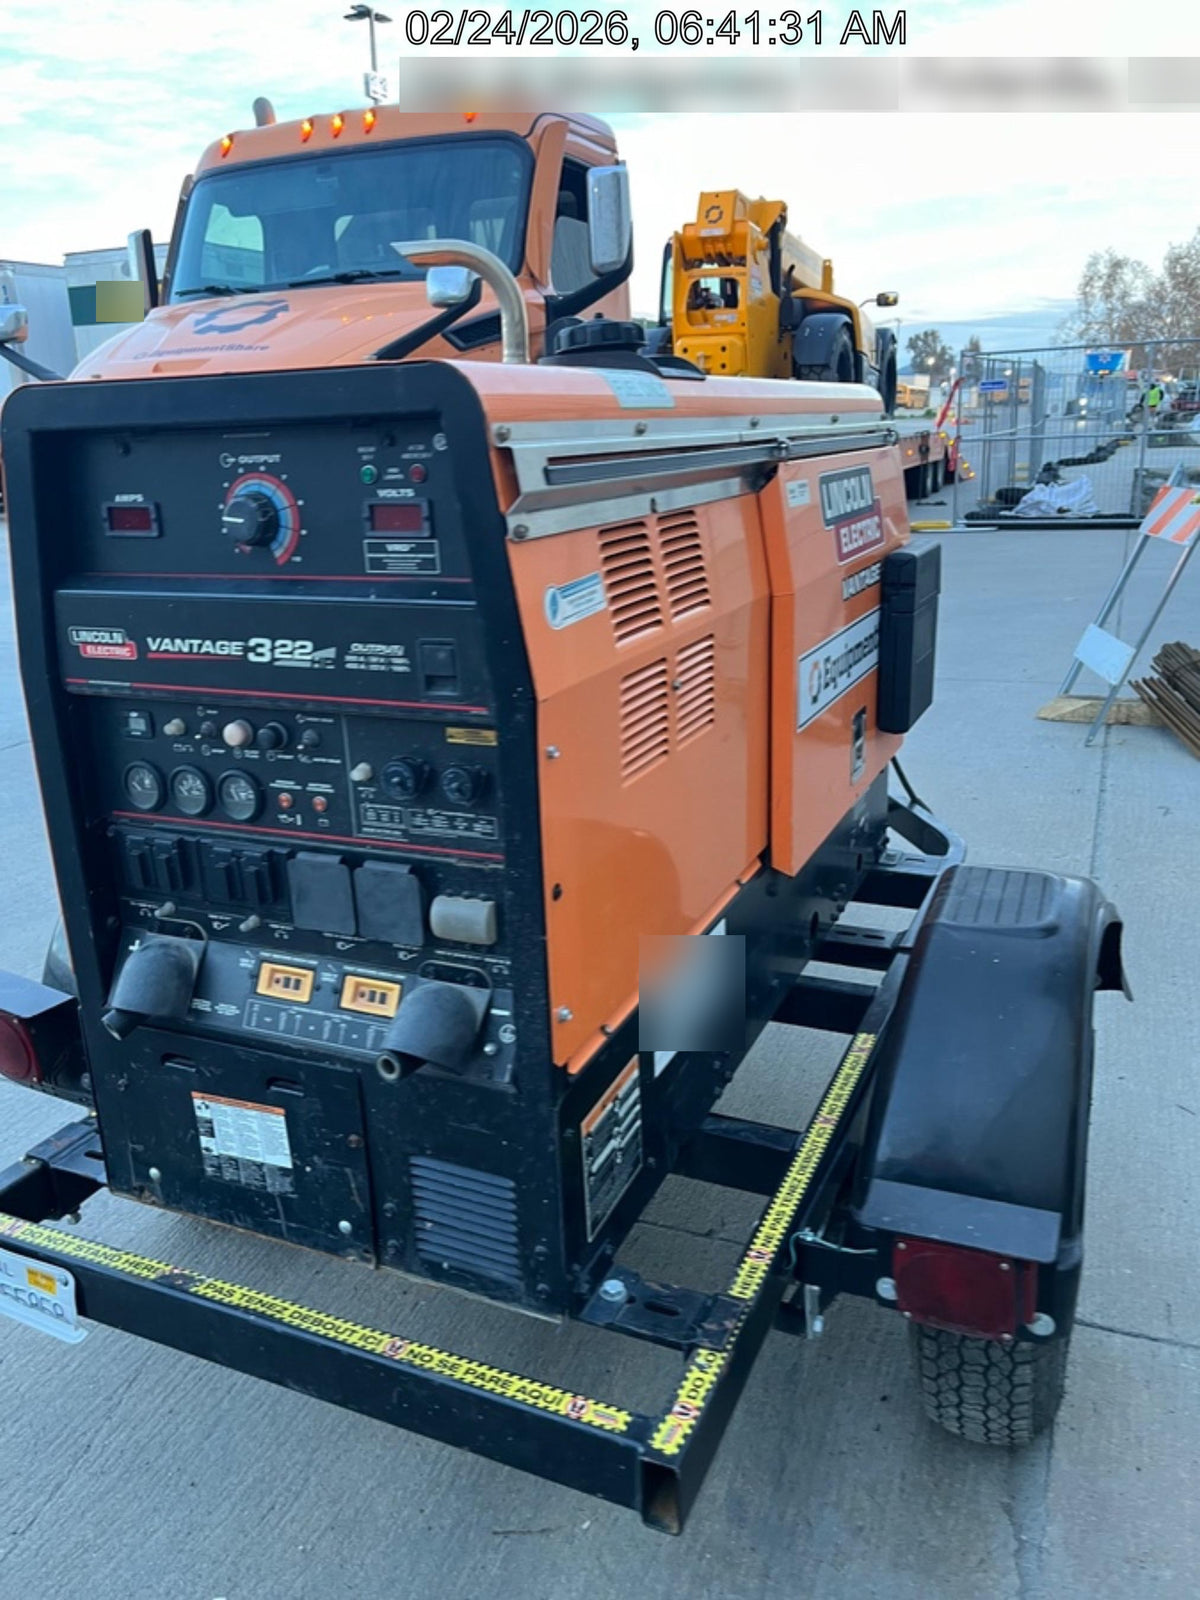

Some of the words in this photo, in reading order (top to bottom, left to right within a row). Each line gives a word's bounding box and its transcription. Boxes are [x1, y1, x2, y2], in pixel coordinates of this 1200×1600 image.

[114, 493, 145, 502] AMPS
[376, 488, 416, 498] VOLTS
[821, 473, 873, 520] LINCOLN
[839, 515, 882, 554] ELECTRIC
[72, 630, 123, 644] LINCOLN
[146, 637, 245, 656] VANTAGE
[246, 637, 314, 662] 322
[86, 645, 133, 657] ELECTRIC
[21, 1228, 43, 1241] DO
[43, 1233, 75, 1249] NOT
[74, 1244, 122, 1263] STAND
[204, 1282, 237, 1299] PAS
[238, 1293, 288, 1315] TENEZ
[288, 1310, 357, 1339] DEBOUT
[357, 1332, 385, 1347] ICI
[405, 1348, 433, 1363] NO
[435, 1358, 460, 1373] SE
[462, 1365, 515, 1391] PARE
[686, 1377, 705, 1400] DO
